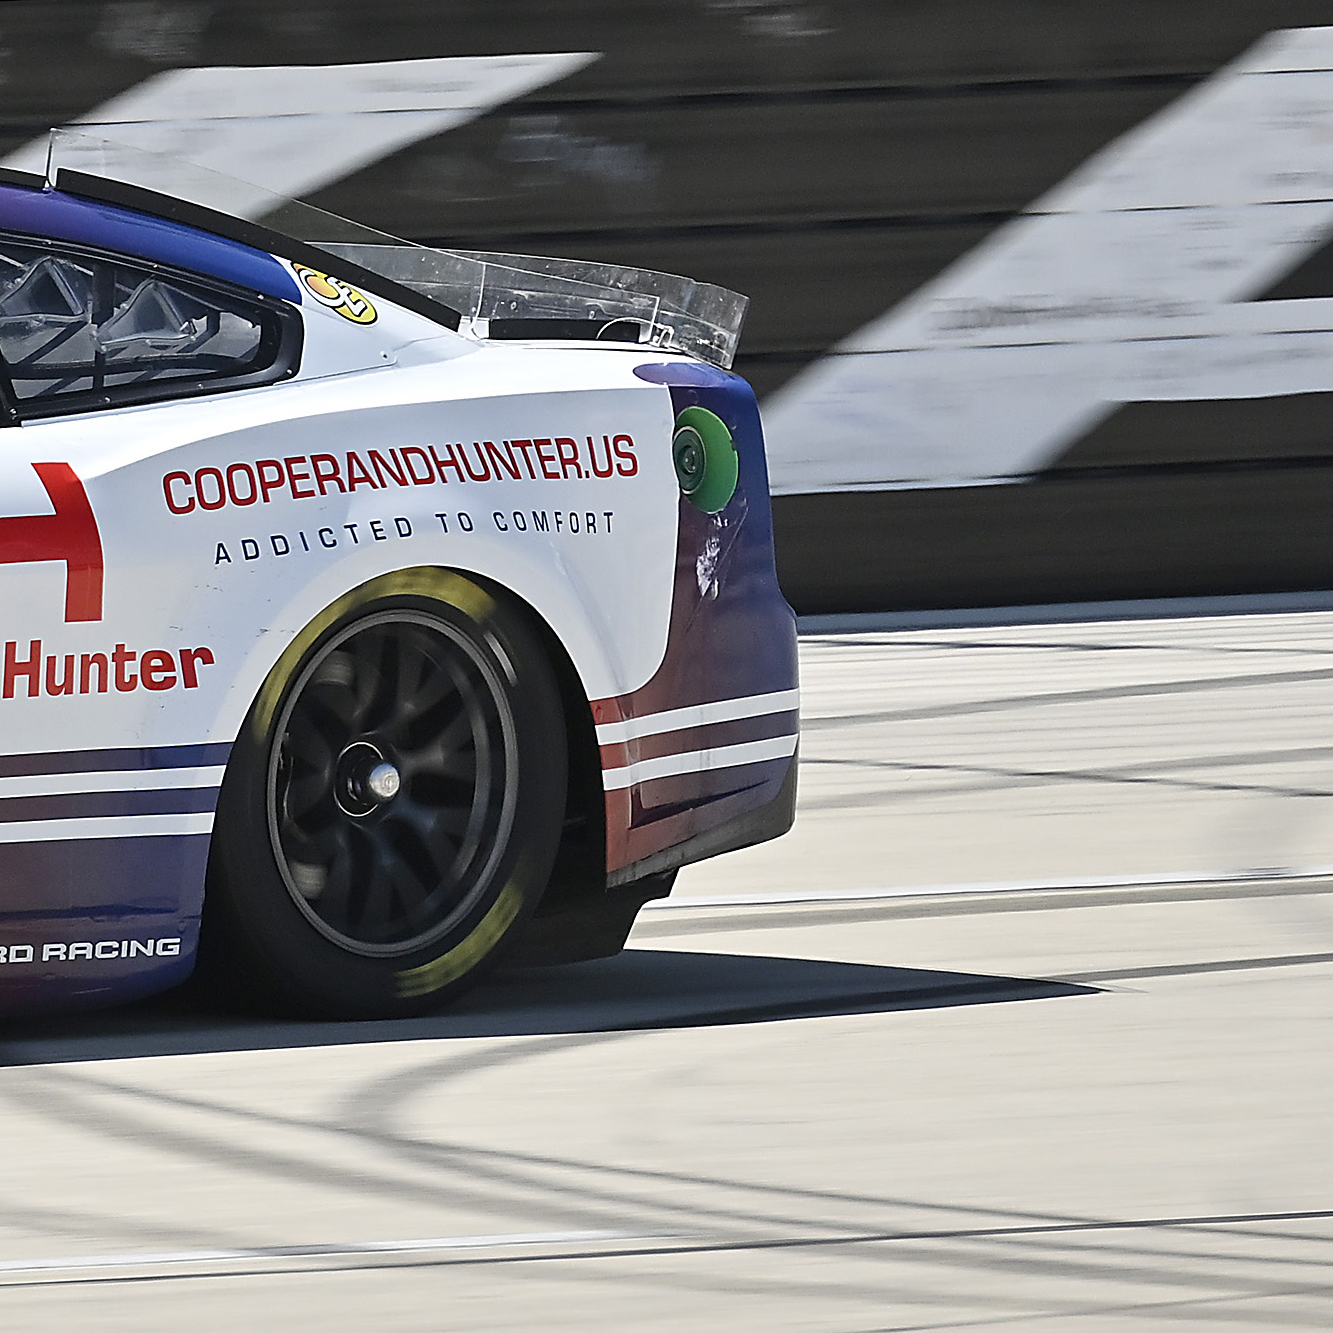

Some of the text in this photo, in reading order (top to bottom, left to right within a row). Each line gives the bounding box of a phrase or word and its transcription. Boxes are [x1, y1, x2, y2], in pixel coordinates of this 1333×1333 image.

[163, 433, 639, 515] COOPERANDHUNTER.US
[214, 510, 615, 565] ADDICTED TO COMFORT
[2, 640, 215, 700] Hunter
[42, 938, 181, 962] RACING
